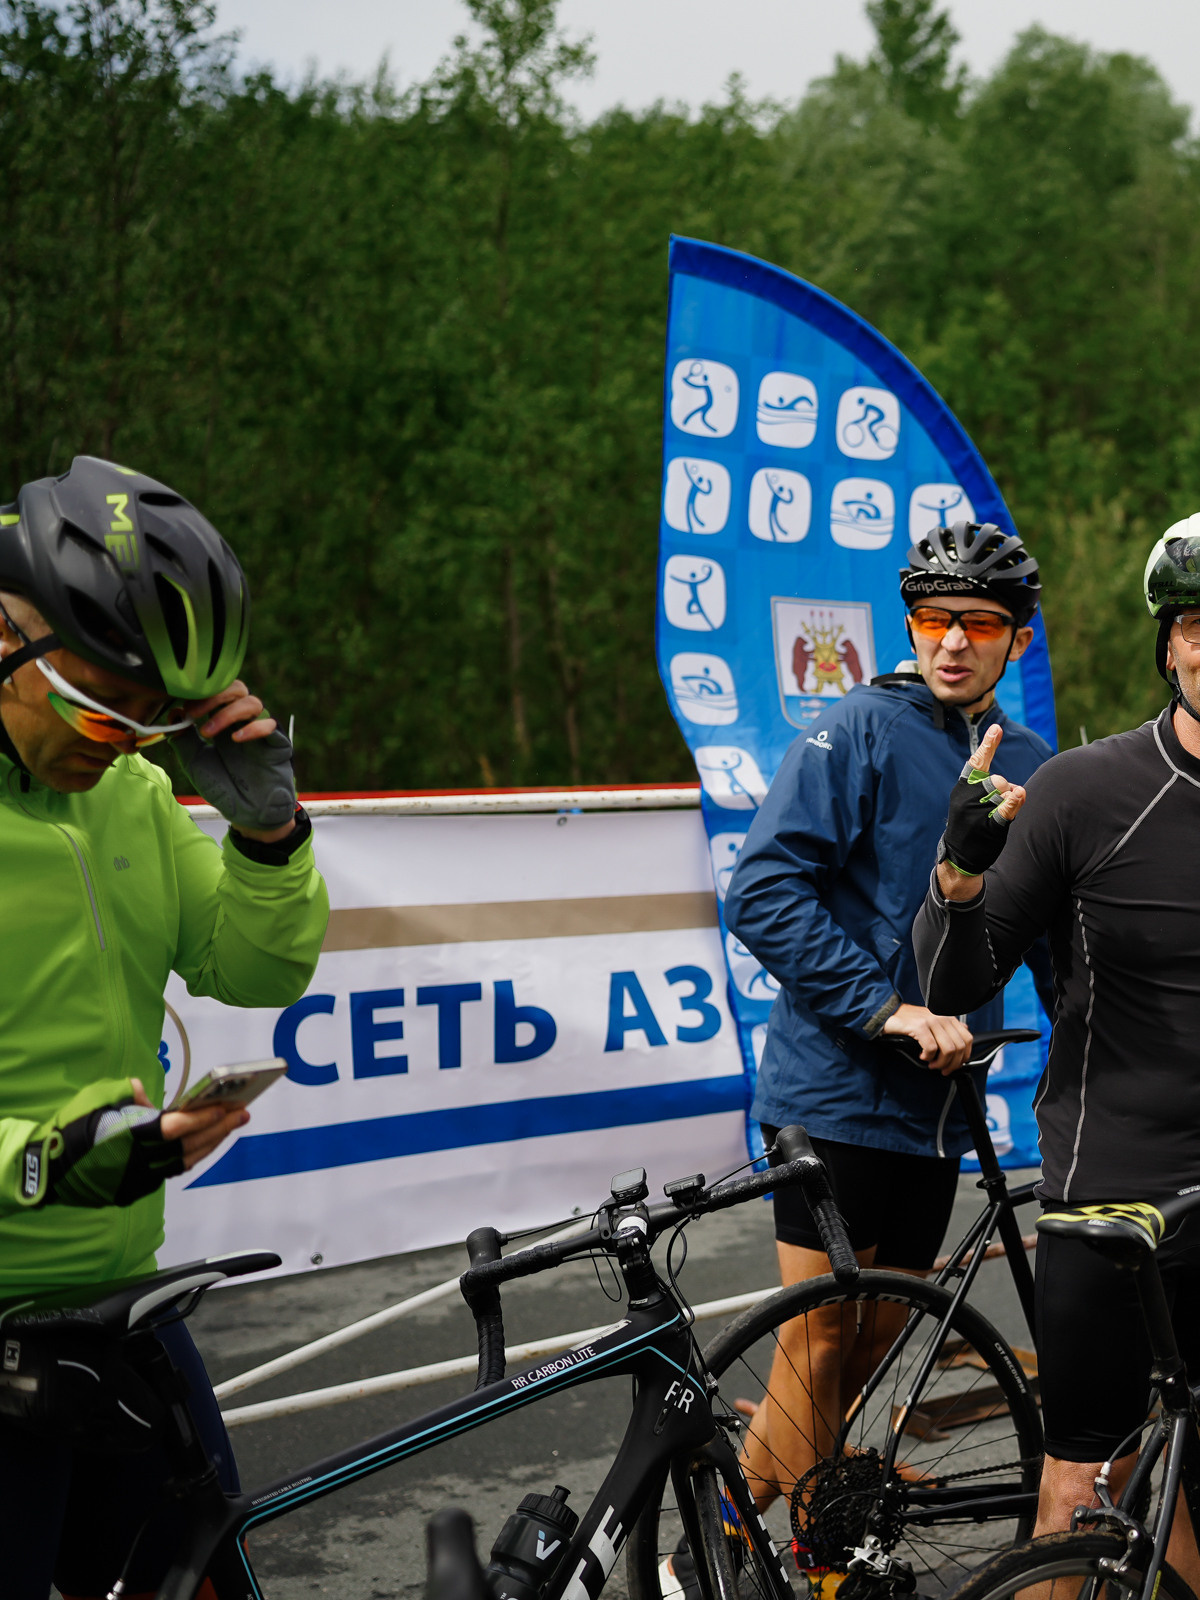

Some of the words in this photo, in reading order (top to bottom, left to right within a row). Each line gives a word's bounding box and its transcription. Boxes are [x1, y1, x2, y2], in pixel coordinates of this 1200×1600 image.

[905, 579, 974, 594] GripGrab
[273, 980, 558, 1087] СЕТЬ
[604, 964, 723, 1053] АЗ
[511, 1376, 529, 1390] RR
[527, 1356, 573, 1382] CARBON
[571, 1346, 596, 1363] LITE
[1003, 1355, 1027, 1394] RECOURSE
[251, 1490, 279, 1506] INTEGRATED
[278, 1484, 292, 1495] CABLE
[292, 1476, 313, 1488] ROUTING
